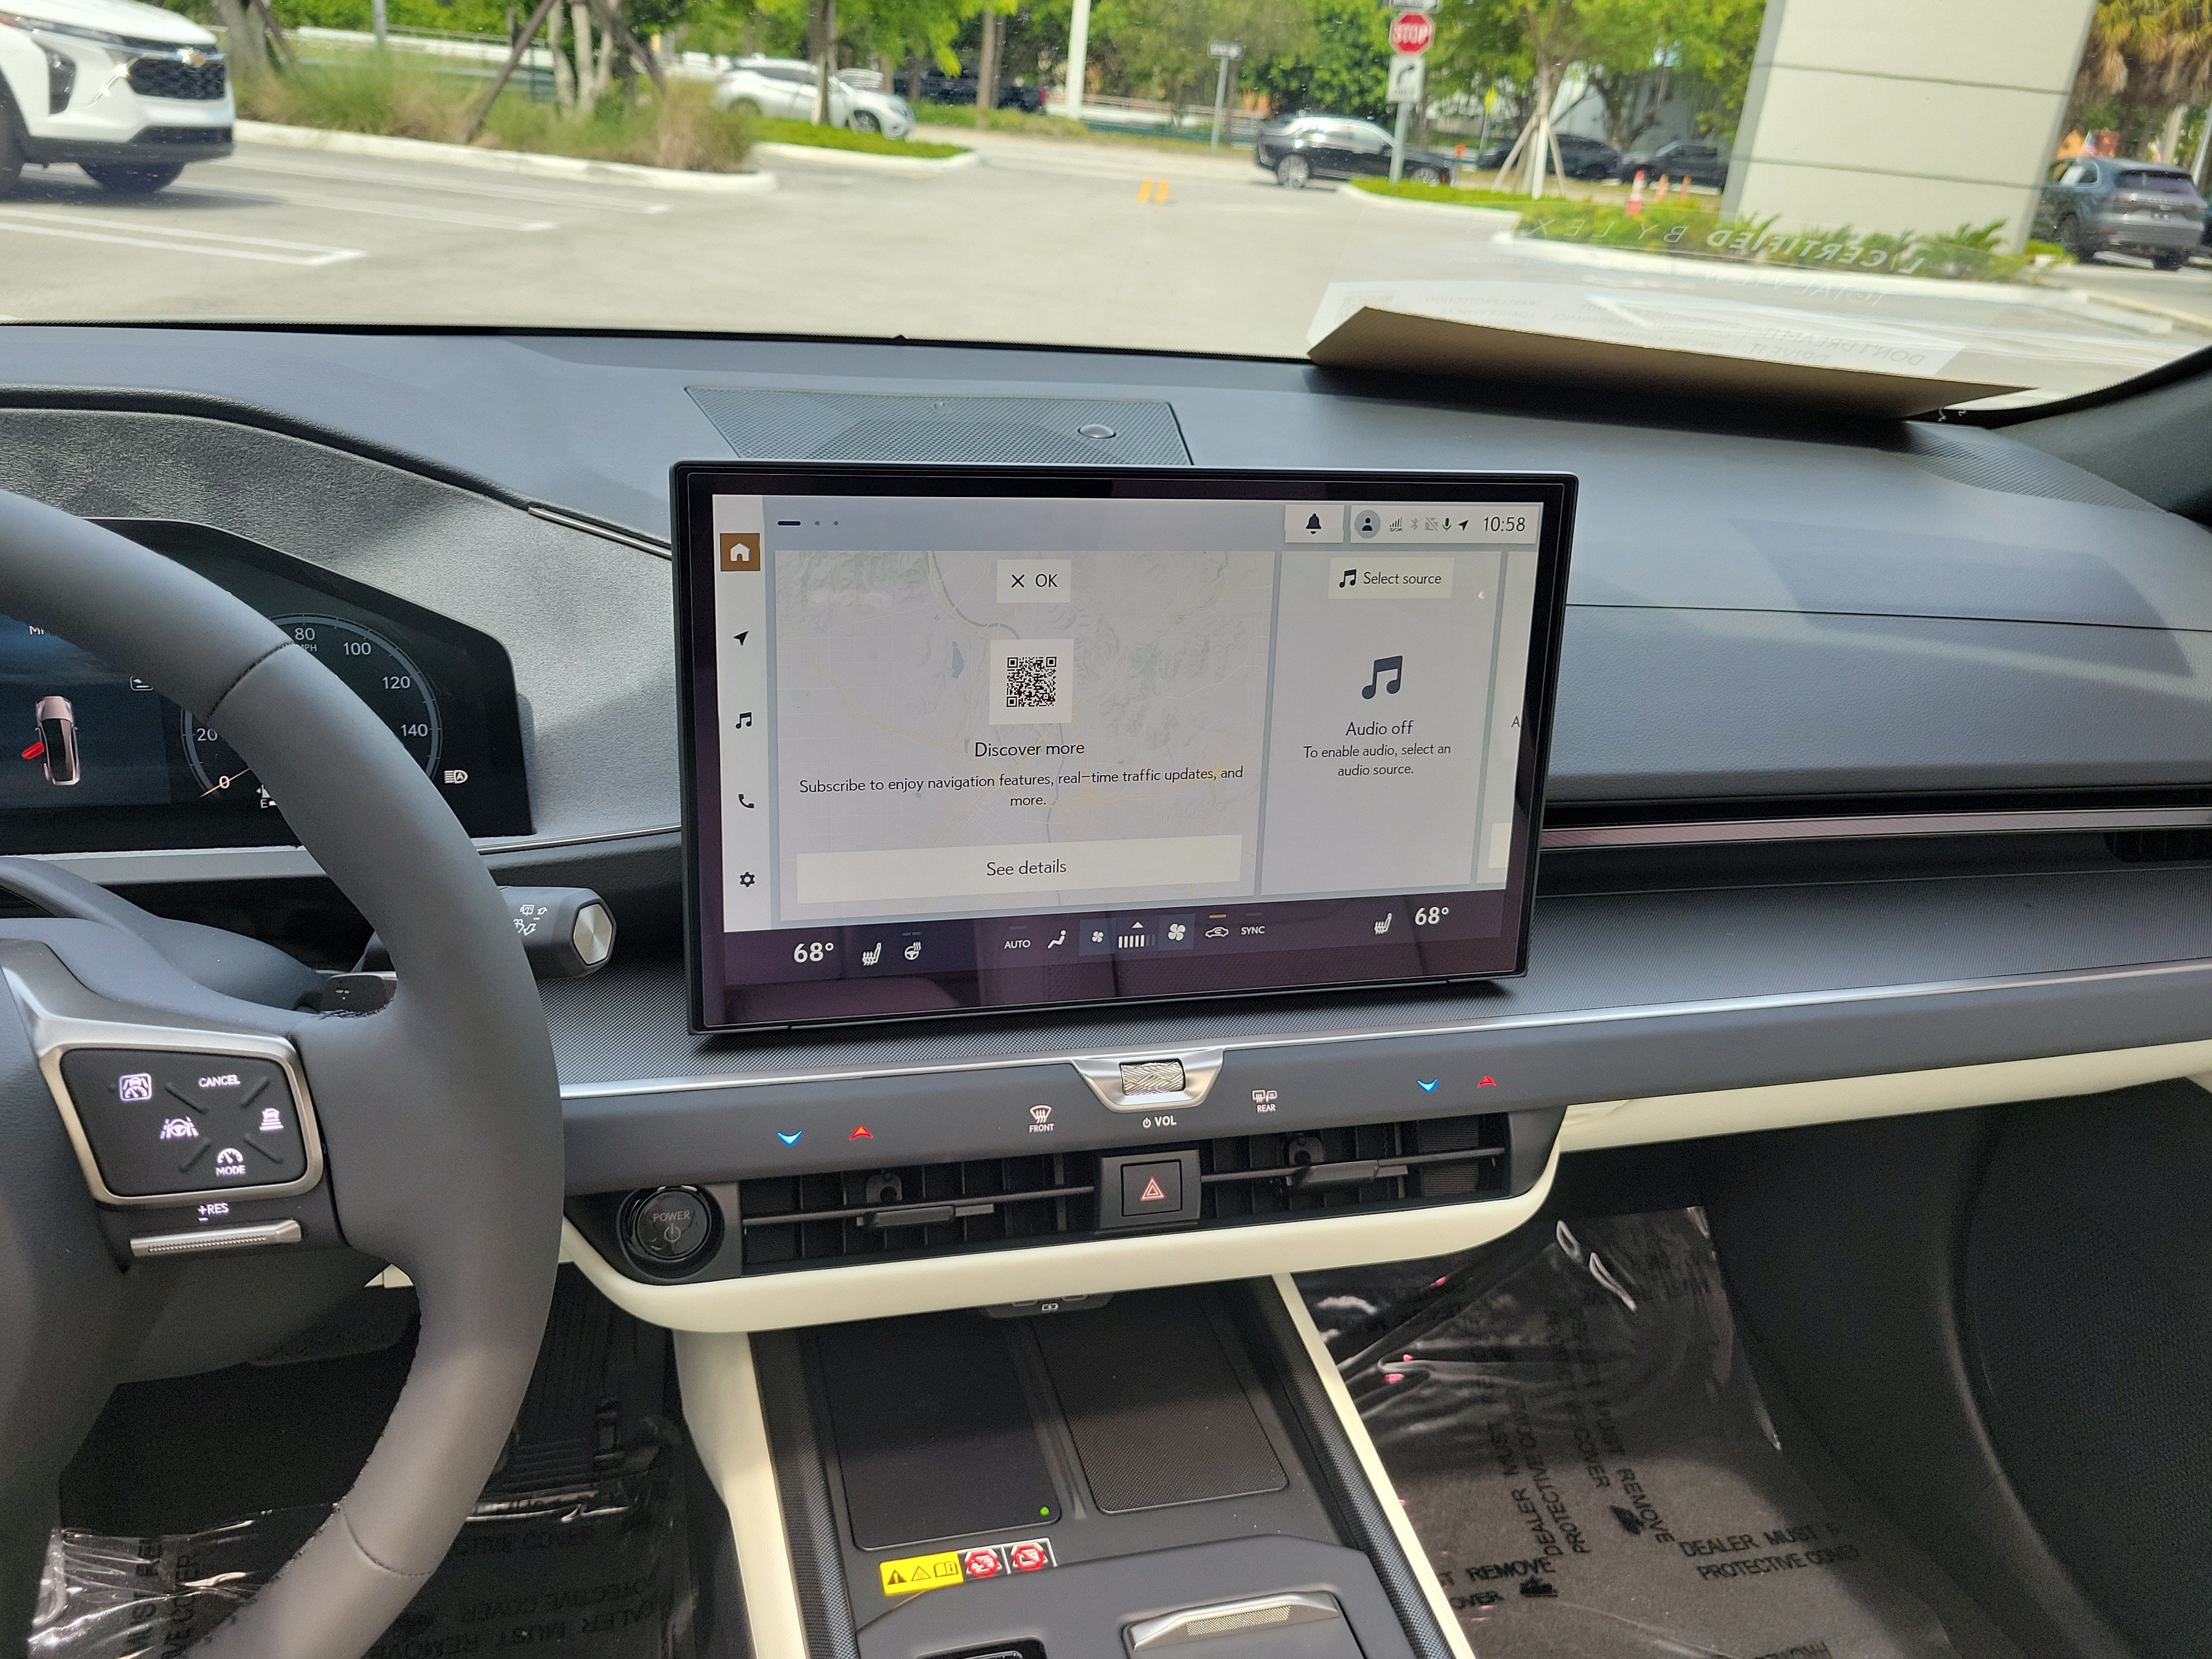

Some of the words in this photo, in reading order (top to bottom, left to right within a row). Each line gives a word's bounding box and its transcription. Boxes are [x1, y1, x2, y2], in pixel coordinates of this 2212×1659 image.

[1393, 24, 1427, 43] STOP
[1483, 517, 1526, 532] 10:58
[1035, 573, 1058, 588] OK
[1363, 572, 1400, 584] Select
[1402, 574, 1442, 584] source
[295, 627, 315, 641] 80
[343, 642, 371, 656] 100
[383, 675, 410, 690] 120
[196, 728, 218, 742] 20
[401, 724, 428, 737] 140
[1345, 721, 1387, 736] Audio
[1391, 720, 1414, 735] off
[974, 742, 1041, 758] Discover
[1045, 743, 1085, 755] more
[1304, 746, 1318, 759] To
[1321, 744, 1359, 758] enable
[1362, 743, 1397, 758] audio,
[1401, 742, 1435, 755] select
[1437, 745, 1451, 754] an
[1338, 763, 1370, 777] audio
[1373, 765, 1414, 776] source.
[219, 775, 230, 789] 0
[799, 778, 866, 793] Subscribe
[870, 780, 884, 791] to
[888, 777, 924, 793] enjoy
[928, 775, 995, 791] navigation
[999, 773, 1054, 787] features,
[1058, 770, 1119, 785] real-time
[1122, 768, 1161, 782] traffic
[1164, 767, 1217, 783] updates,
[1220, 765, 1244, 778] and
[260, 799, 268, 809] E
[1010, 795, 1047, 806] more.
[986, 861, 1014, 876] See
[1018, 859, 1067, 874] details
[1240, 926, 1266, 935] SYNC
[1003, 939, 1031, 950] AUTO
[198, 1074, 241, 1087] CANCEL
[1257, 1104, 1277, 1113] REAR
[1029, 1123, 1054, 1133] FRONT
[1154, 1115, 1177, 1127] VOL
[216, 1165, 246, 1176] MODE
[653, 1210, 691, 1222] POWER
[1524, 1451, 1593, 1554] PROTECTIVE
[1617, 1467, 1676, 1544] REMOVE
[1512, 1487, 1564, 1557] DEALER
[1678, 1533, 1760, 1558] DEALER
[1764, 1524, 1819, 1545] MUST
[1465, 1555, 1556, 1582] REMOVE
[1696, 1553, 1808, 1581] PROTECTIVE
[1448, 1588, 1505, 1611] OVER
